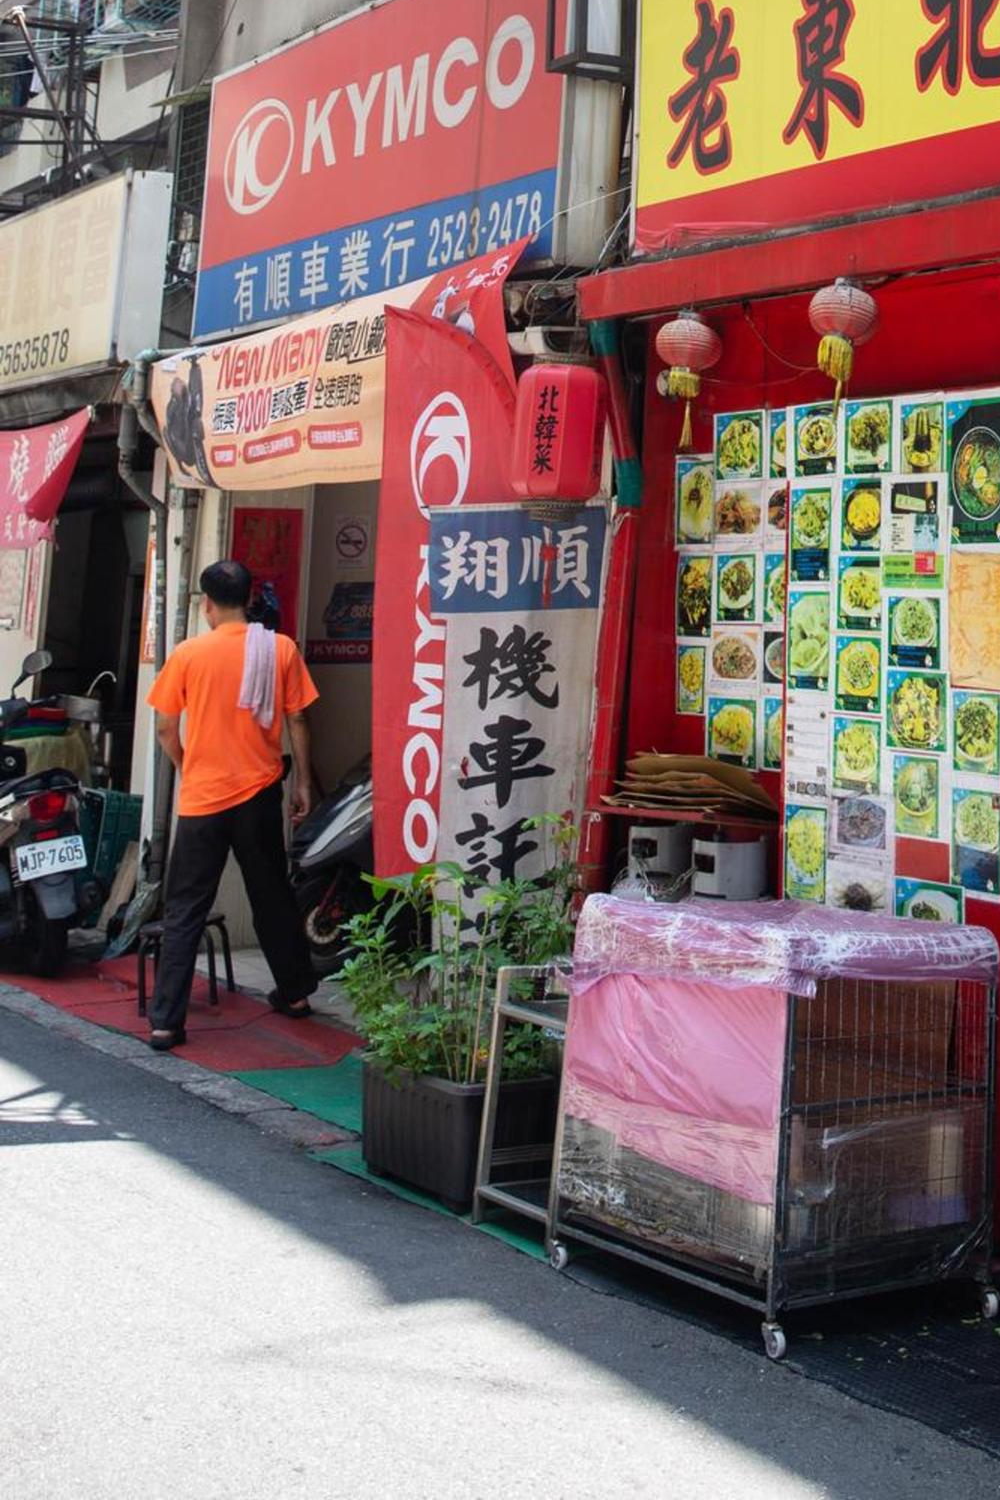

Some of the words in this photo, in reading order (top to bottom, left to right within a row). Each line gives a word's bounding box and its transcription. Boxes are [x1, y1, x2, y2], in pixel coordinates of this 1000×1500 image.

[301, 15, 536, 174] KYMCO
[233, 220, 417, 323] 有順車業行
[531, 384, 561, 476] 北韓菜
[439, 524, 593, 601] 翔順
[313, 643, 370, 656] KYMCO
